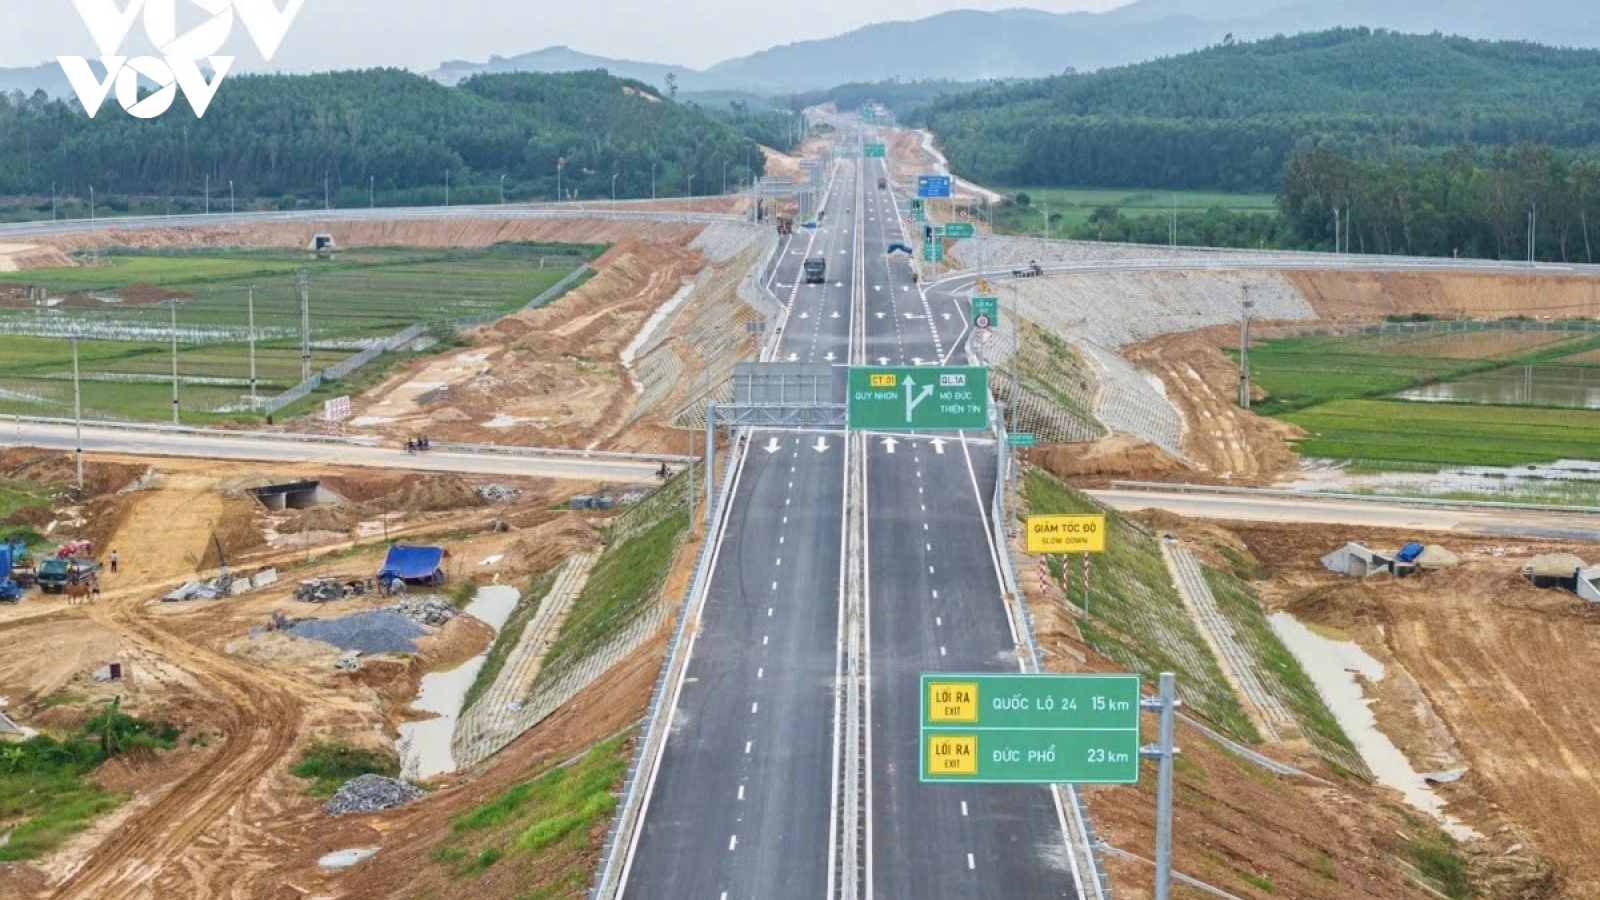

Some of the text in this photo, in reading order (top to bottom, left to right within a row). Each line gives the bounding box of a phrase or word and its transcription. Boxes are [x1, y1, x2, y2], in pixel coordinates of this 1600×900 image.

[855, 391, 872, 400] QUY
[1034, 520, 1097, 533] GIẢM TỐC ĐỘ
[1041, 537, 1088, 545] SLOW DOWN
[935, 687, 970, 703] LỐI RA
[992, 693, 1129, 713] QUỐC LỘ 24 15 km
[944, 706, 961, 716] EXIT
[935, 740, 970, 756] LỐI RA
[992, 744, 1129, 762] ĐỨC PHỔ 23 km
[944, 759, 960, 769] EXIT
